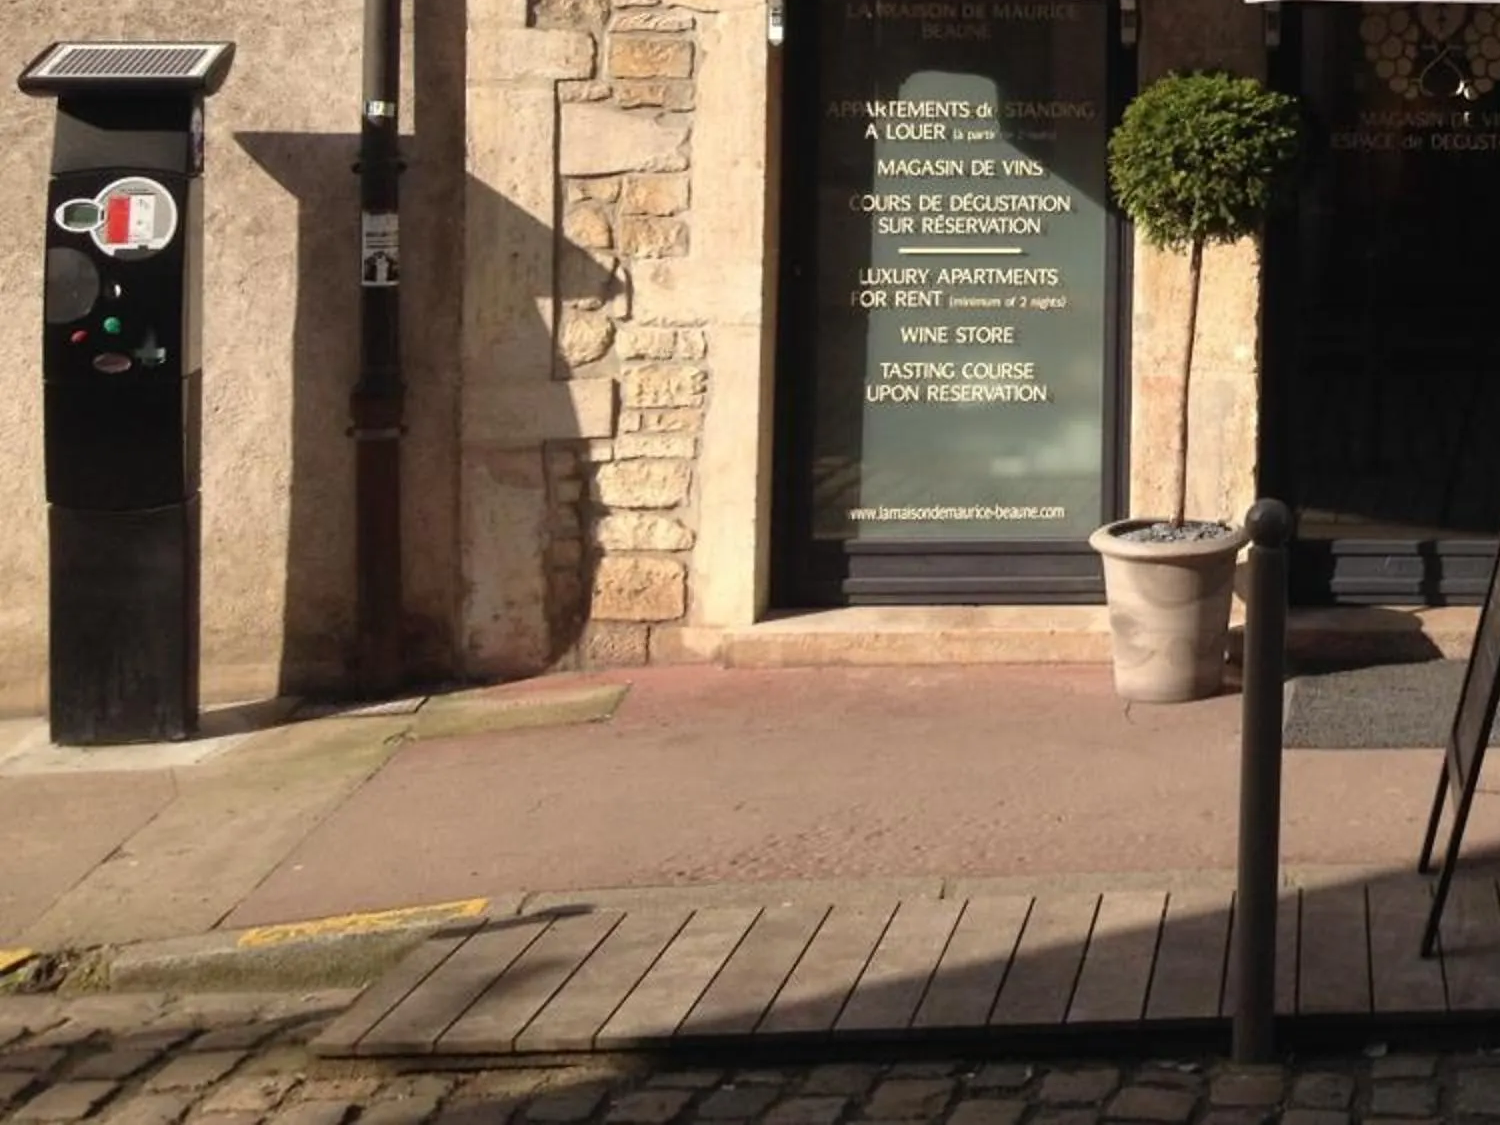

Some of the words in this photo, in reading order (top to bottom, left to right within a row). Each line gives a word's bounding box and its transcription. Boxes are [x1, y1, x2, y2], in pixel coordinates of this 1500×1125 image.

[961, 2, 983, 20] DE
[993, 2, 1083, 21] MAURICE
[826, 100, 970, 119] APPARTEMENTS
[1005, 101, 1095, 120] STANDING
[886, 123, 946, 141] LOUER
[877, 158, 964, 177] MAGASIN
[970, 159, 995, 176] DE
[1002, 159, 1044, 177] VINS
[850, 194, 911, 213] COURS
[919, 195, 943, 212] DE
[949, 190, 1072, 213] DÉGUSTATION
[878, 217, 914, 235] SUR
[921, 214, 1041, 235] RÉSERVATION
[859, 268, 929, 286] LUXURY
[937, 268, 1059, 286] APARTMENTS
[851, 290, 888, 308] FOR
[895, 290, 943, 308] RENT
[949, 295, 1001, 309] (minimum
[1005, 295, 1017, 308] of
[1018, 295, 1029, 308] 2
[1030, 295, 1068, 311] nights)
[900, 326, 949, 344] WINE
[955, 326, 1015, 344] STORE
[880, 362, 955, 380] TASTING
[961, 362, 1035, 380] COURSE
[866, 385, 919, 402] UPON
[926, 384, 1047, 403] RESERVATION
